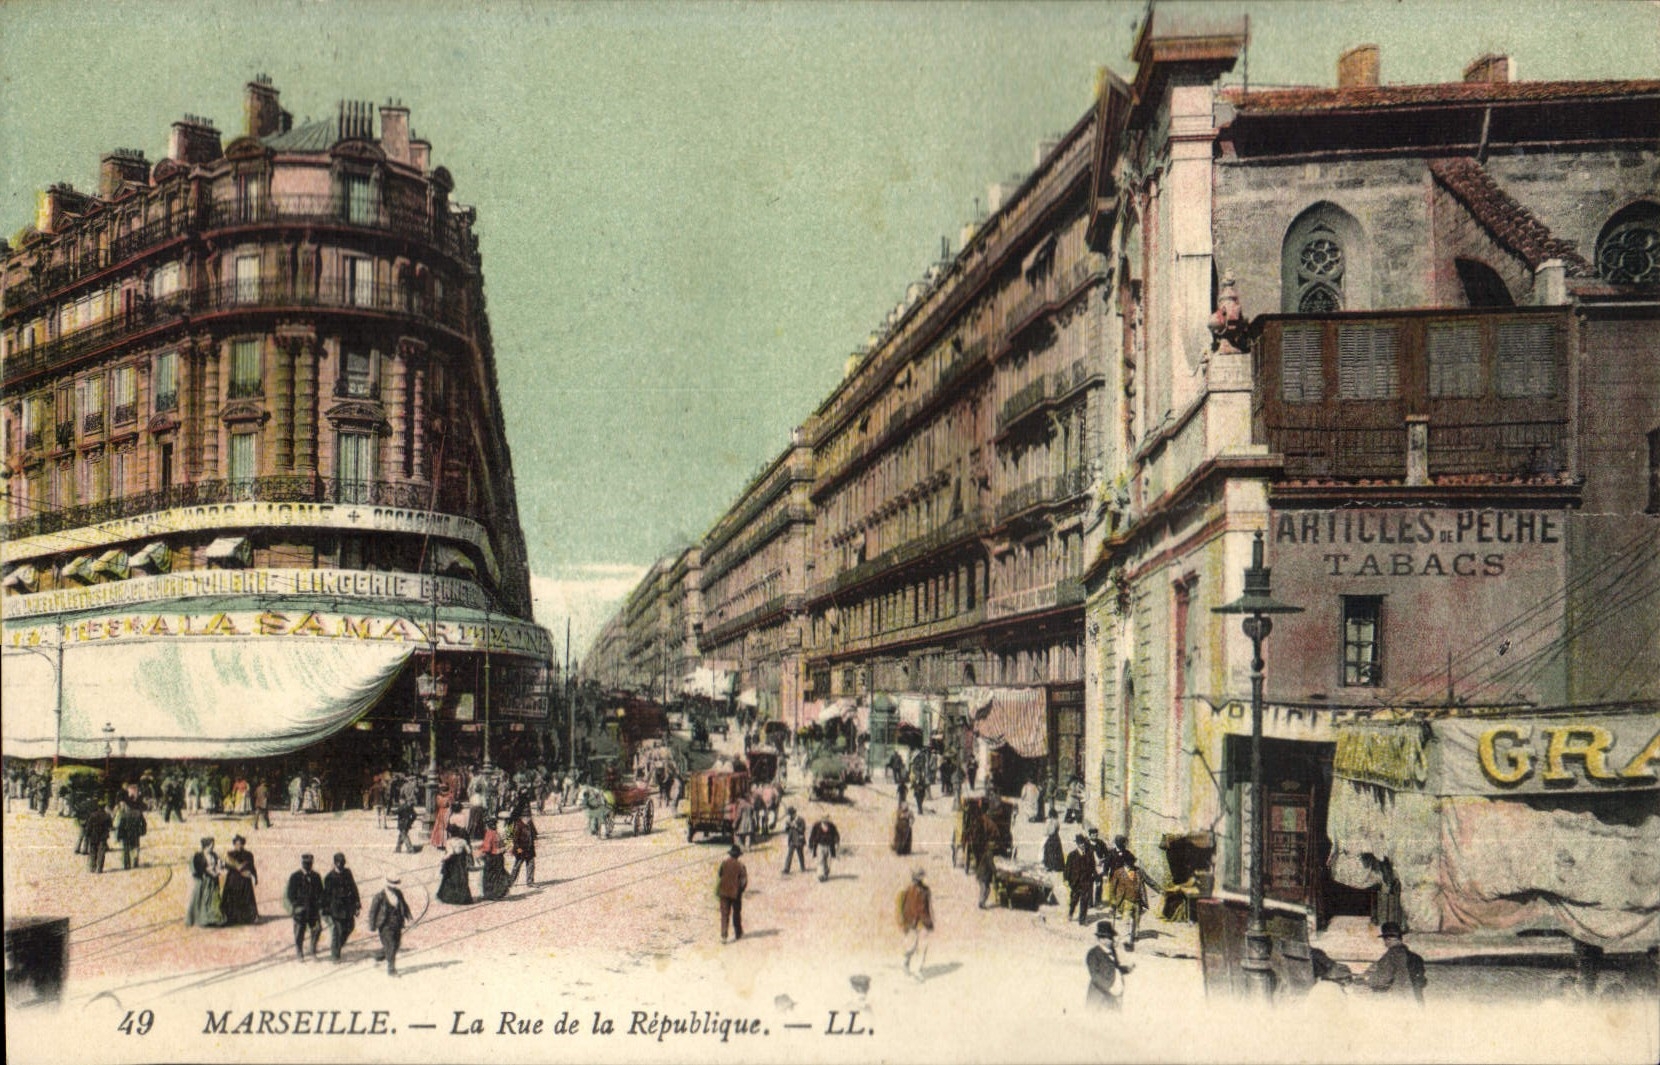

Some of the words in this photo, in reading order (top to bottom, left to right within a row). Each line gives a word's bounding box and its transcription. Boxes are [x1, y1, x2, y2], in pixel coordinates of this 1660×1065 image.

[1276, 509, 1435, 544] ARTICLES
[1440, 529, 1453, 543] DE
[1323, 552, 1506, 577] TABACS
[293, 571, 407, 597] LINGERIE
[254, 611, 549, 654] SAMARITAINE
